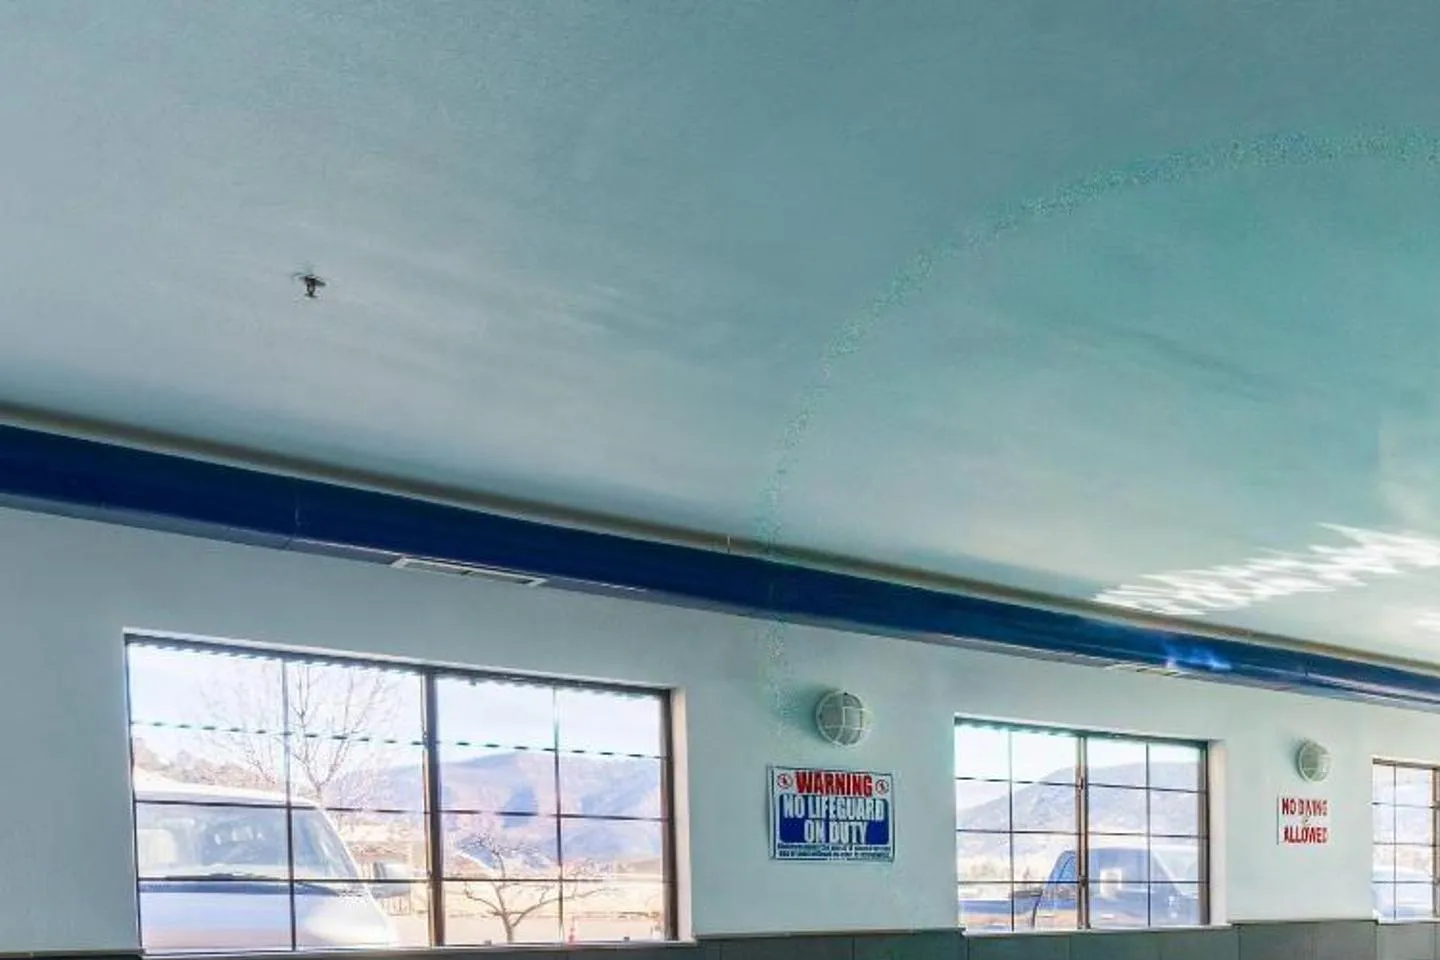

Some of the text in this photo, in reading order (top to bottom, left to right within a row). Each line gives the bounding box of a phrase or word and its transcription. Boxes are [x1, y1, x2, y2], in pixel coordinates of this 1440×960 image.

[796, 771, 873, 797] WARNING
[782, 794, 885, 821] NO LIFEGUARD
[1282, 798, 1296, 815] NO
[804, 819, 867, 845] ON DUTY
[1284, 826, 1328, 843] ALLOWED
